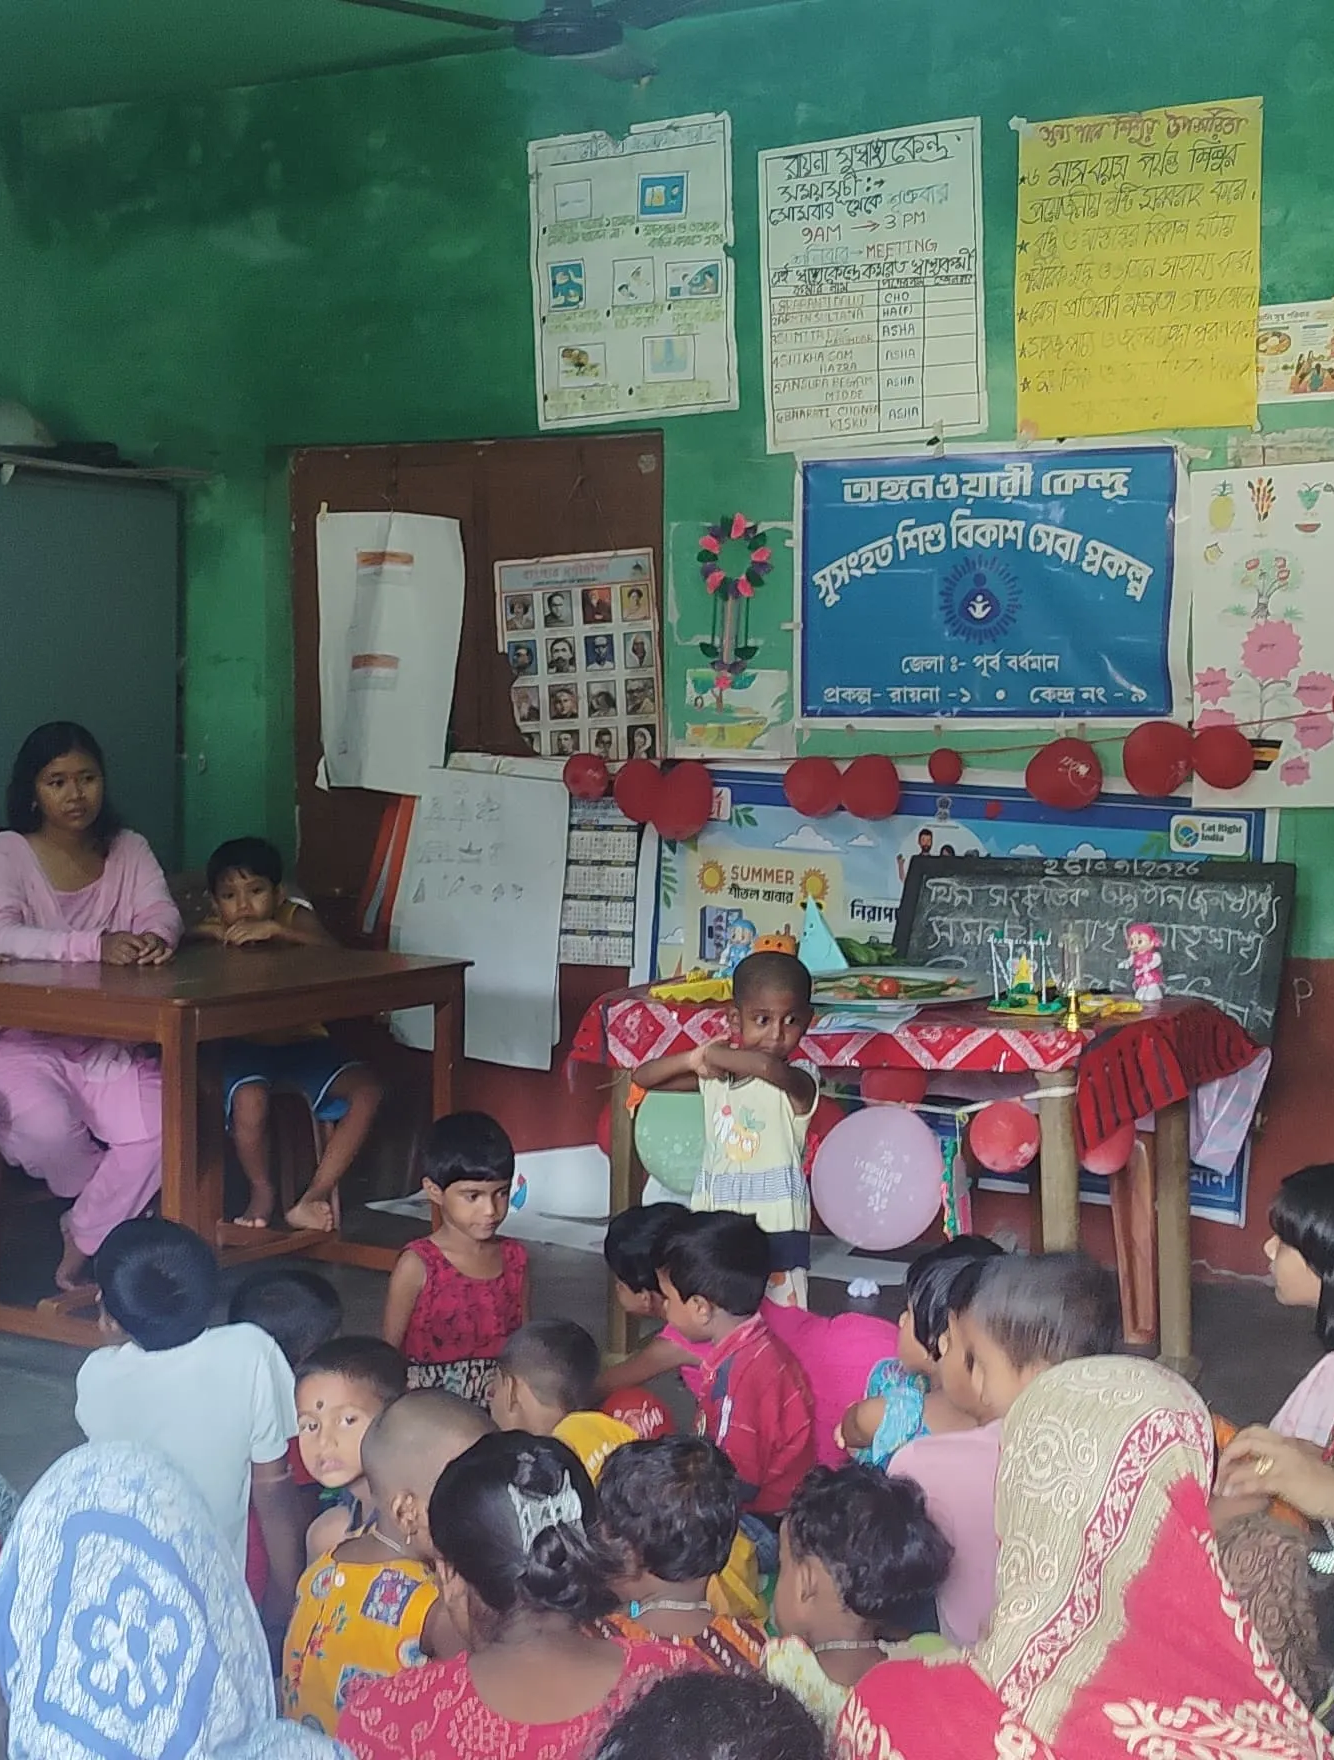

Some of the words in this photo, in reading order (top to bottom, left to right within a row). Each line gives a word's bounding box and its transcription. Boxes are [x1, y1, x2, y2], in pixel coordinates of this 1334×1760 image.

[769, 201, 834, 225] সোমবার
[847, 194, 882, 217] থেকে
[802, 224, 841, 244] 9AM
[884, 214, 897, 229] 3
[903, 211, 925, 227] PM
[867, 239, 938, 260] MEETING
[885, 291, 909, 303] CHO
[883, 321, 915, 337] ASHA
[886, 348, 915, 361] ASHA
[887, 375, 915, 388] ASHA
[889, 405, 919, 420] ASHA
[830, 418, 867, 431] KISKU
[1041, 467, 1132, 499] কেন্দ্র
[812, 536, 895, 607] সুসংহত
[895, 518, 946, 561] শিশু
[950, 508, 1025, 551] বিকাশ
[1028, 521, 1083, 564] সেবা
[1080, 540, 1155, 602] প্রকল্প
[901, 654, 945, 674] জেলা
[972, 650, 1001, 678] পূর্ব
[1005, 650, 1060, 673] বর্ধমান
[888, 685, 940, 704] রায়না
[1029, 685, 1075, 705] কেন্দ্র
[1081, 685, 1108, 704] নং
[1201, 823, 1216, 833] Eat
[1218, 824, 1242, 835] Right
[1201, 833, 1224, 842] India
[730, 865, 795, 886] SUMMER
[728, 882, 760, 901] শীতল
